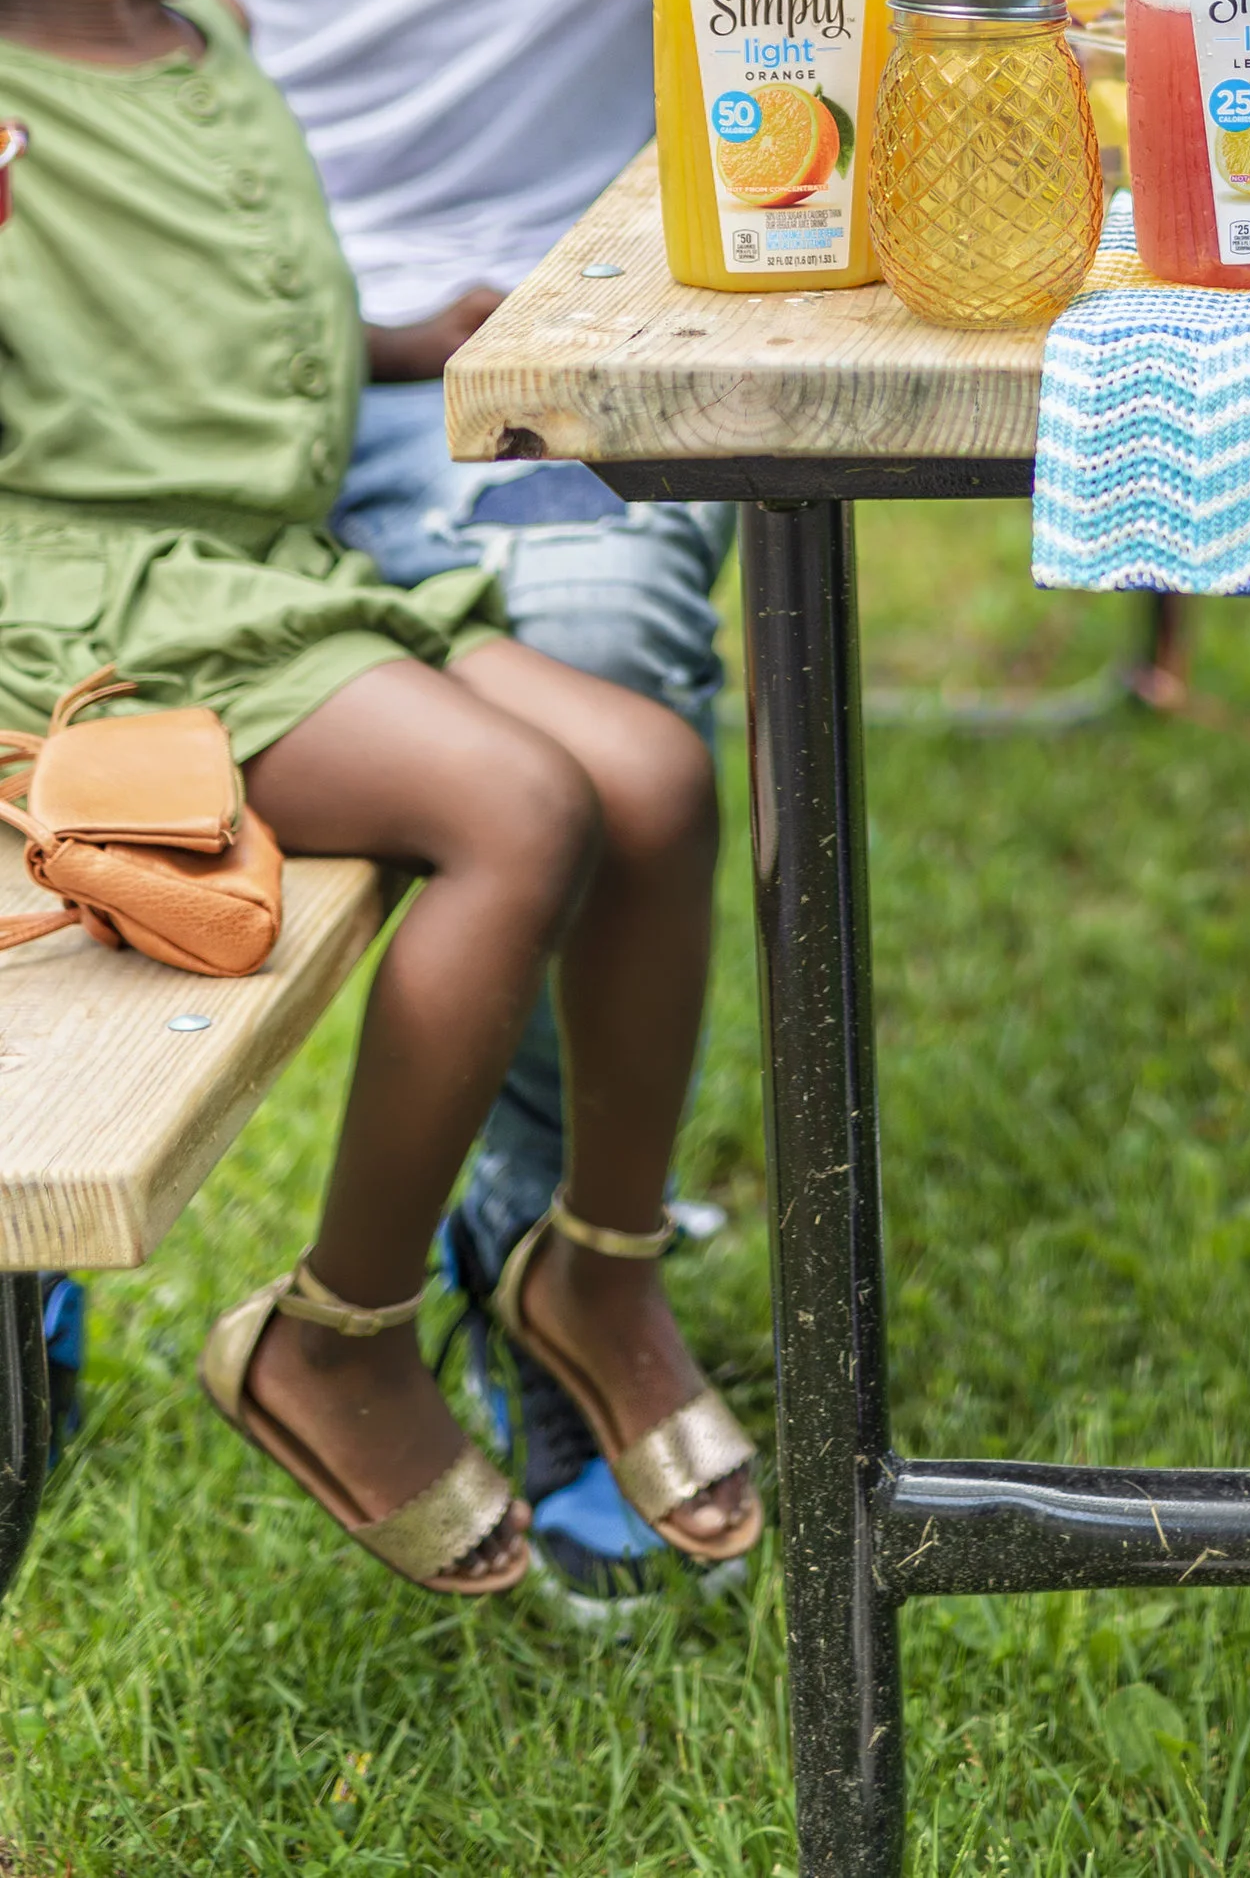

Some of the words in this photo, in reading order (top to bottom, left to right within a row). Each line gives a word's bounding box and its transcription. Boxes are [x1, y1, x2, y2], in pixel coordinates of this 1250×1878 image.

[744, 38, 815, 68] light
[745, 70, 816, 81] ORANGE
[718, 100, 755, 126] 50
[1230, 174, 1248, 182] NOT
[767, 257, 775, 266] 52
[776, 256, 784, 265] FL
[785, 256, 793, 265] OZ
[819, 254, 831, 263] 1.53
[833, 254, 837, 263] L
